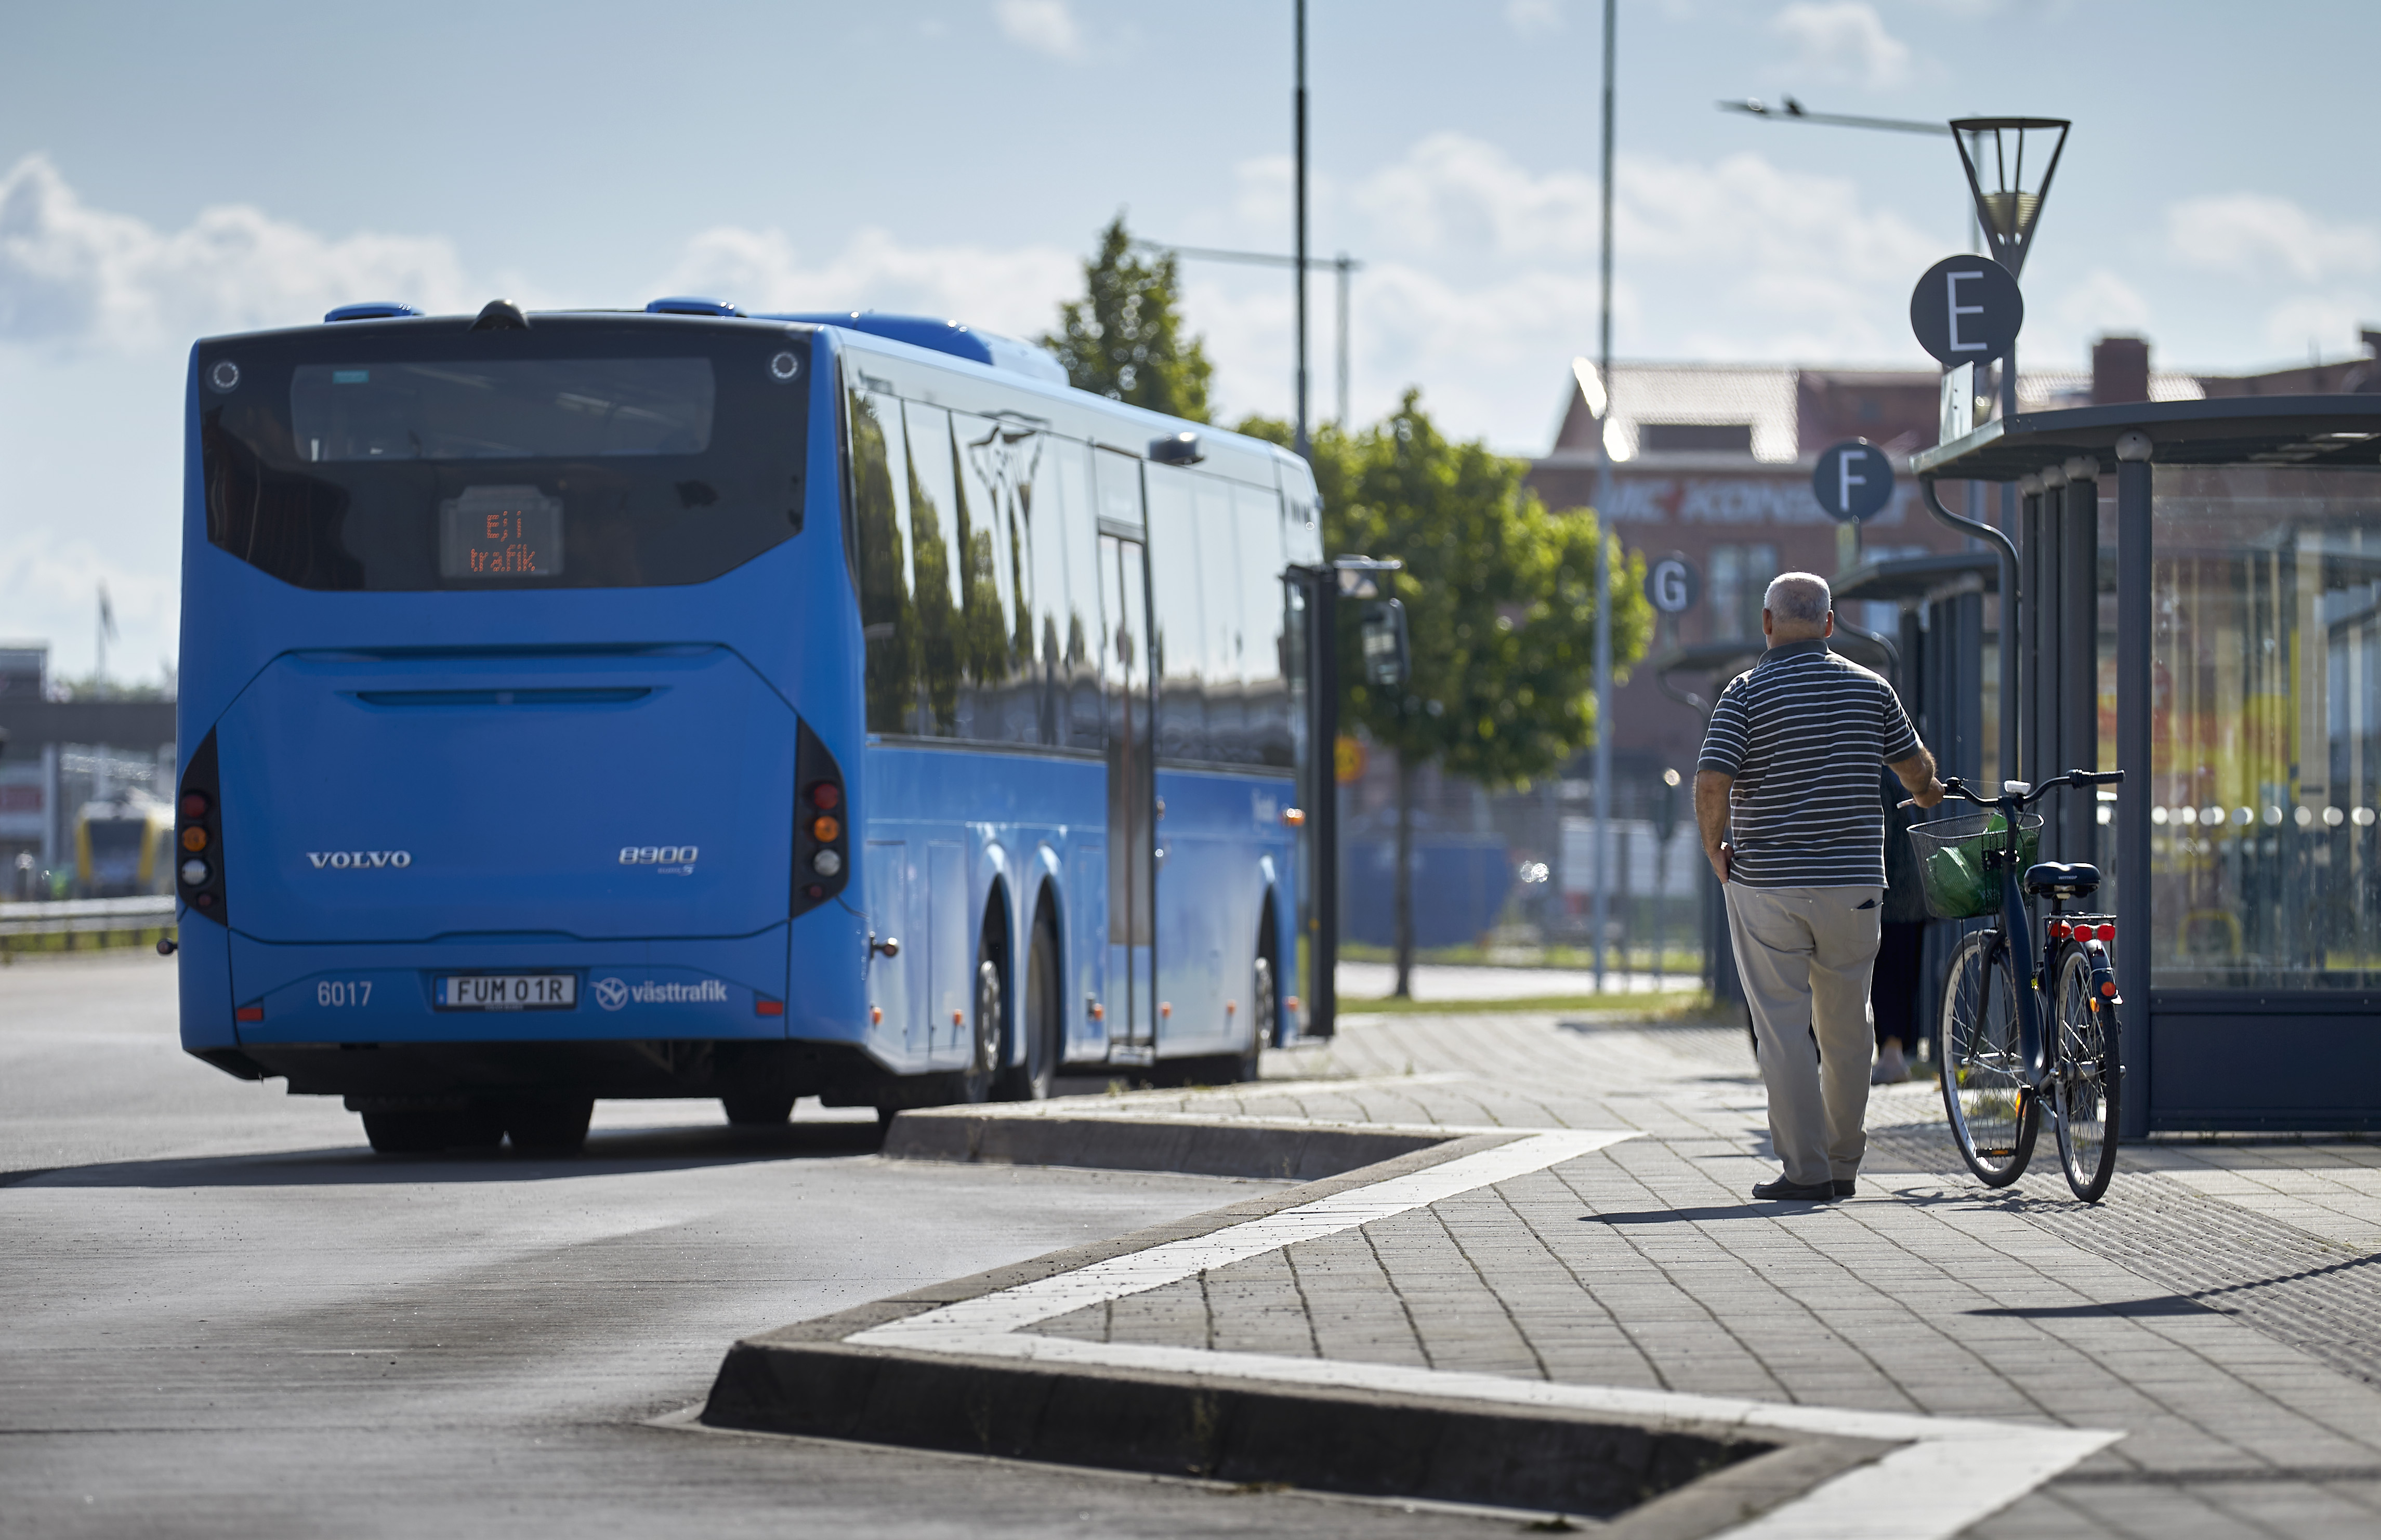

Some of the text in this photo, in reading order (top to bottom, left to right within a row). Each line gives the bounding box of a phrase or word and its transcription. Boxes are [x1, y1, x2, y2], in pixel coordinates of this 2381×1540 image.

[1946, 271, 1988, 352] E
[1839, 451, 1867, 512] F
[487, 511, 521, 542] Ej i
[471, 544, 535, 572] trafik
[1654, 560, 1687, 612] G
[306, 850, 412, 868] VOLVO
[619, 846, 699, 865] 8900
[317, 980, 373, 1007] 6017
[458, 980, 506, 1002] FUM
[632, 980, 727, 1003] västtrafik
